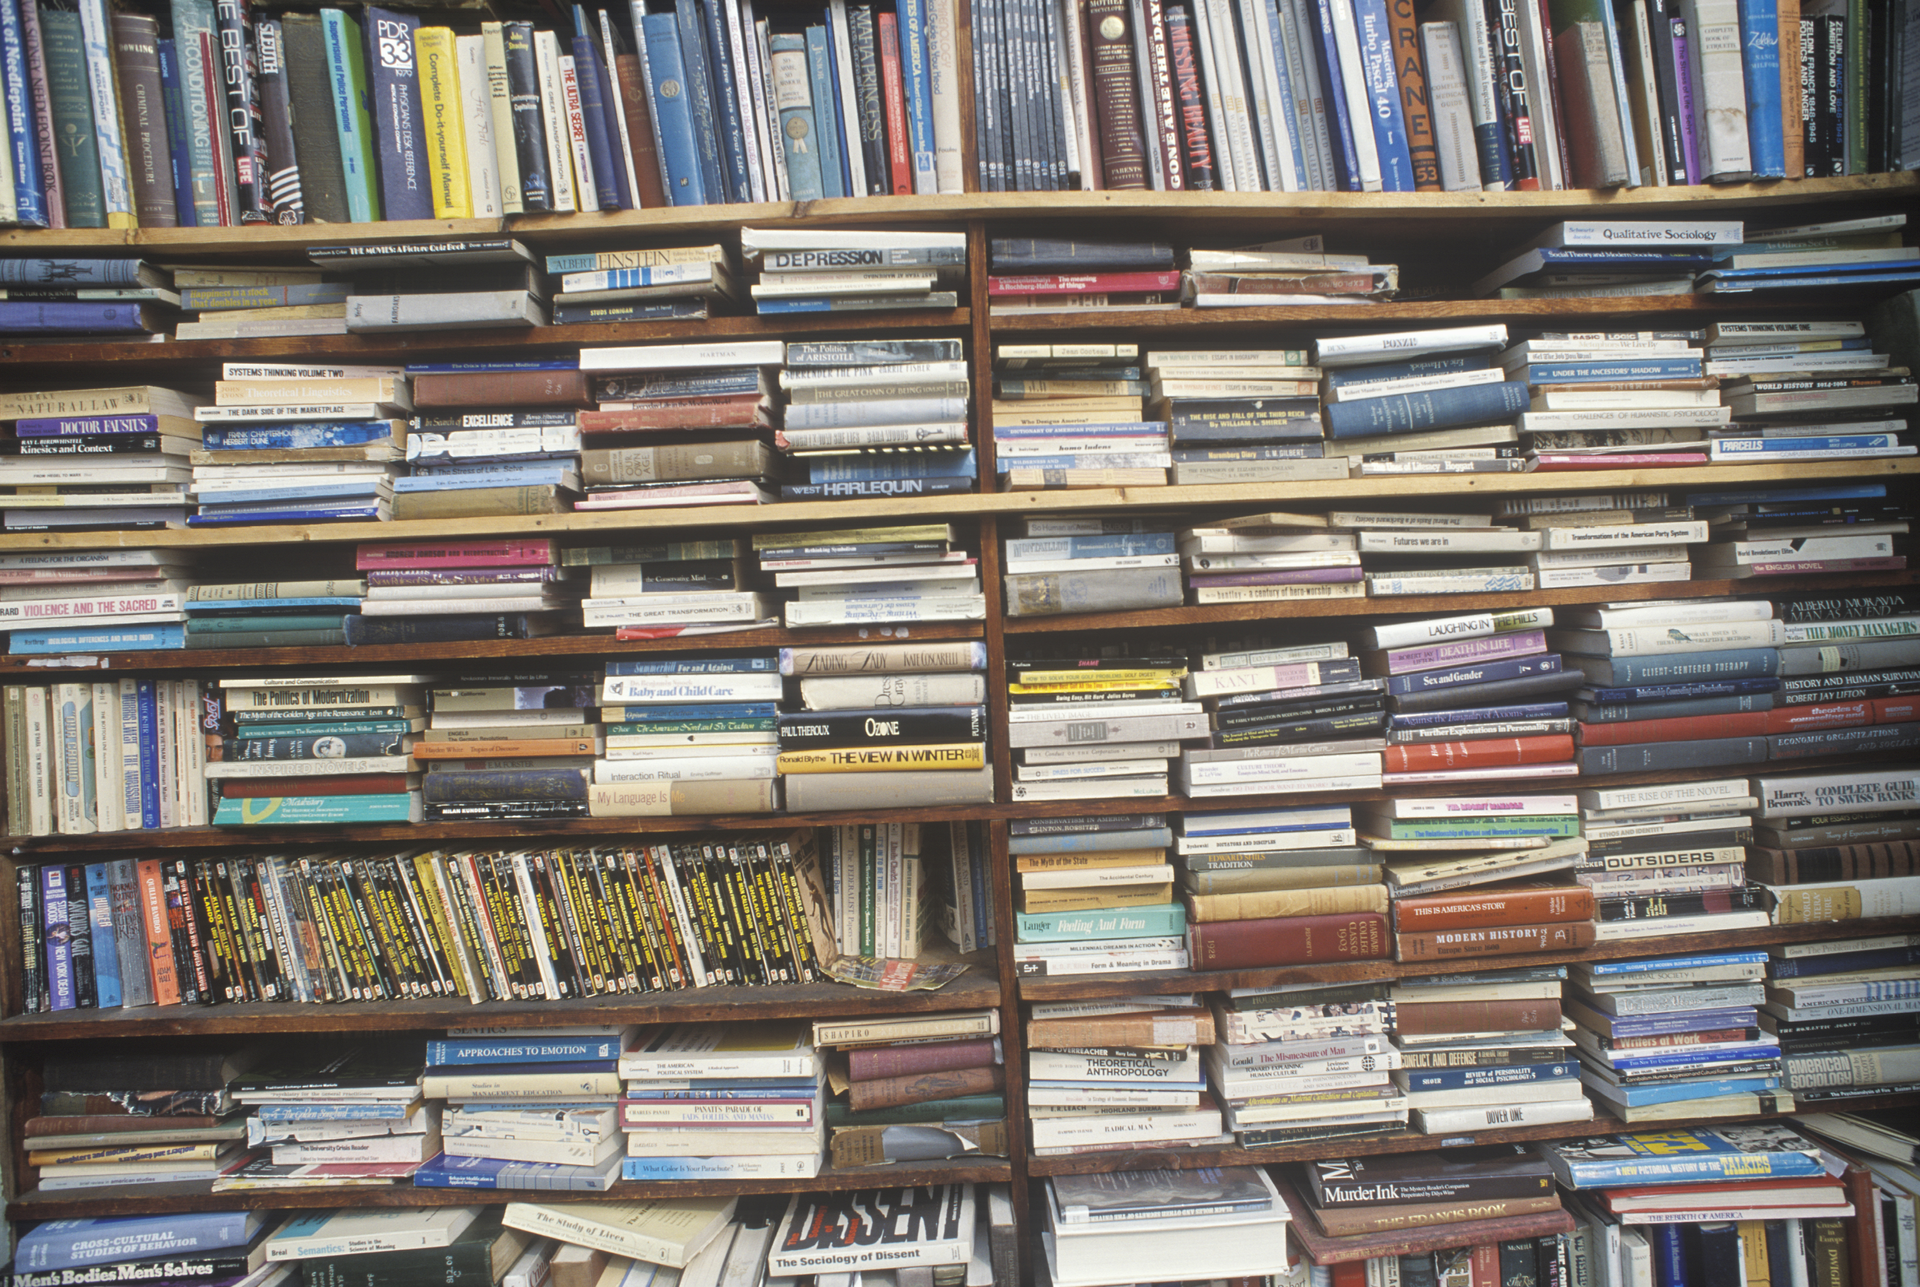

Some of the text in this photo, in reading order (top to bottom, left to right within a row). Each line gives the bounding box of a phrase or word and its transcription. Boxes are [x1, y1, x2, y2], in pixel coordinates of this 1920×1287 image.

[378, 20, 409, 39] PDR
[1806, 21, 1814, 54] ZELDIN
[1748, 31, 1778, 49] Zelda
[1800, 21, 1808, 62] POLITICS
[381, 41, 412, 65] 33
[722, 63, 730, 83] Five
[1364, 13, 1391, 118] Turbo Pascal 4.0
[1380, 40, 1395, 88] Mastering
[4, 28, 24, 134] of Needlepoint
[222, 29, 250, 145] BEST OF
[564, 68, 585, 143] THE ULTRA SECRET
[725, 86, 734, 113] Years
[1170, 26, 1212, 170] MISSING BEAUTY
[1808, 96, 1816, 143] 1848-1945
[136, 84, 155, 185] CRIMINAL PROCEDURE
[429, 53, 454, 208] Complete Do-it-yourself Manual
[732, 130, 740, 152] Your
[238, 158, 251, 182] LIFE
[1416, 166, 1438, 182] 53
[1603, 229, 1717, 241] Qualitative Sociology
[555, 259, 593, 270] ALBERT
[599, 251, 670, 268] EINSTEIN
[776, 251, 882, 267] DEPRESSION
[608, 307, 633, 315] LONIGAN
[802, 345, 847, 353] The Politics
[806, 352, 854, 362] ARISTOTLE
[229, 368, 344, 378] SYSTEMS THINKING VOLUME TWO
[228, 408, 241, 416] THE
[243, 408, 259, 416] DARK
[261, 407, 275, 415] SIDE
[299, 406, 345, 414] MARKETPLACE
[60, 418, 148, 434] DOCTOR FAUSTUS
[462, 414, 514, 427] EXCELLENCE
[1722, 440, 1763, 452] PARCELLS
[792, 480, 923, 495] WEST HARLEQUIN
[23, 599, 157, 617] VIOLENCE AND THE SACRED
[1428, 612, 1539, 637] LAUGHING IN THE HILLS
[1423, 670, 1484, 685] Sex and Gender
[253, 689, 370, 706] The Politics of Modernization
[629, 686, 733, 697] Baby and Child Care
[781, 725, 830, 737] PAUL THEROUX
[779, 754, 826, 763] Ronald Blythe
[830, 749, 964, 765] THE VIEW IN WINTER
[1767, 799, 1811, 808] Browne's
[1774, 790, 1805, 800] Harry
[1607, 851, 1715, 868] OUTSIDERS
[146, 878, 161, 933] QUILLER BAMBOO
[425, 889, 437, 915] HONDO
[503, 891, 517, 924] CATLOW
[700, 872, 719, 928] SILVER CANYON
[1414, 902, 1505, 916] THIS IS AMERICA'S STORY
[513, 895, 525, 926] CHANCY
[536, 893, 549, 927] TAGGART
[597, 899, 607, 921] FLINT
[1057, 916, 1146, 933] Feeling And Form
[1436, 929, 1538, 943] MODERN HISTORY
[457, 1045, 586, 1058] APPROACHES TO EMOTION
[1086, 1059, 1155, 1068] THEORETICAL
[1086, 1068, 1169, 1077] ANTHROPOLOGY
[1486, 1108, 1524, 1124] DOVER ONE
[1622, 1166, 1637, 1175] NEW
[1639, 1164, 1670, 1174] PICTORIAL
[1672, 1163, 1697, 1173] HISTORY
[1710, 1161, 1721, 1170] THE
[1721, 1156, 1771, 1175] TALKIES
[1325, 1185, 1398, 1203] Murder Ink
[71, 1231, 175, 1251] CROSS-CULTURAL
[71, 1237, 197, 1259] STUDIES OF BEHAVIOR
[776, 1249, 921, 1269] The Sociology of Dissent
[14, 1262, 213, 1287] Men's Bodies Men's Selves
